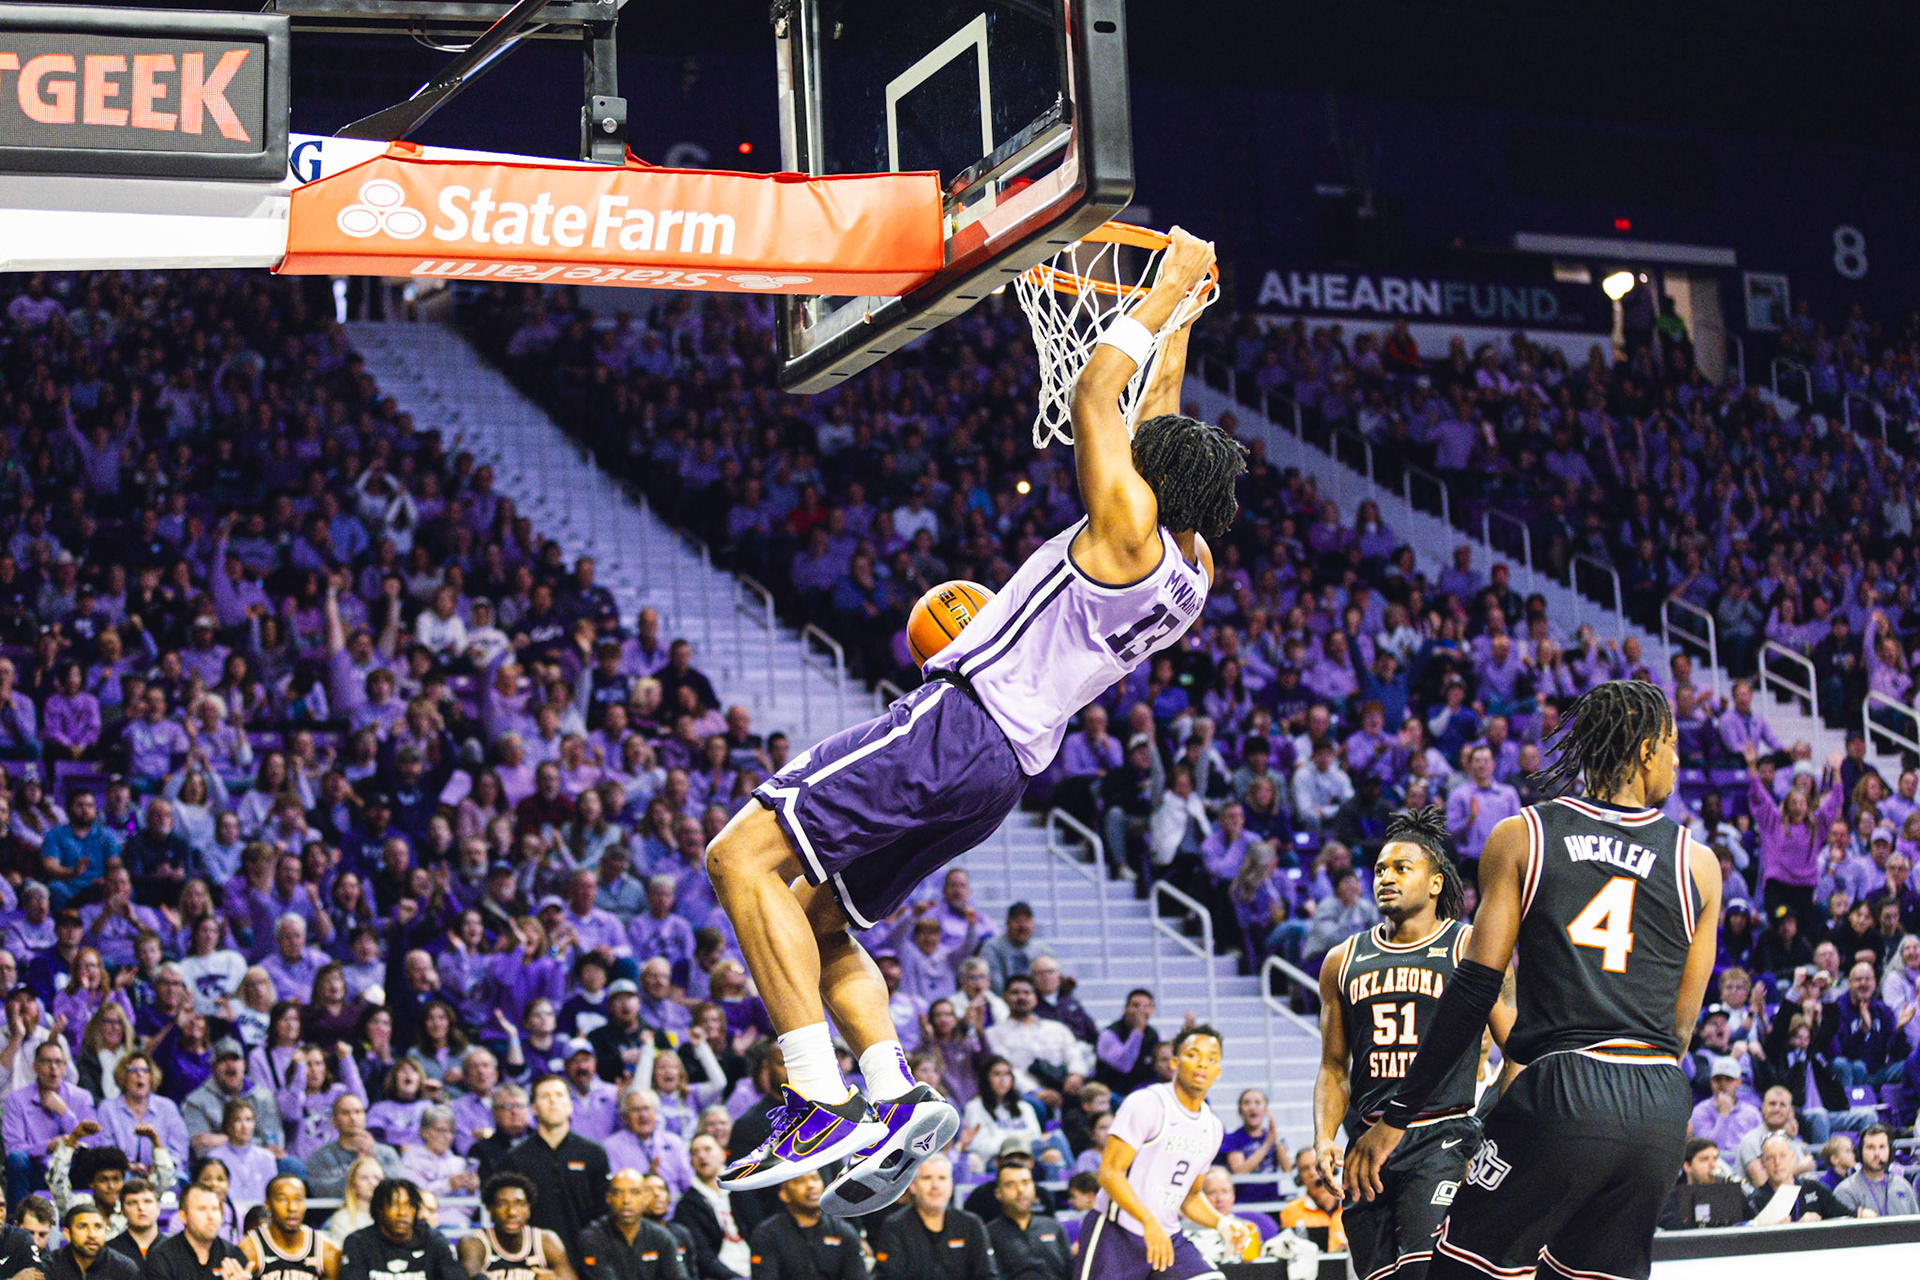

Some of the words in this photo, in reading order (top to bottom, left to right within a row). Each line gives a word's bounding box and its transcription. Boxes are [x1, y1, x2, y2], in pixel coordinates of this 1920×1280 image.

[0, 48, 250, 142] GEEK
[1834, 226, 1867, 280] 8
[1105, 603, 1180, 662] 13
[1563, 834, 1657, 879] HICKLEN
[1566, 876, 1637, 974] 4
[1350, 967, 1444, 1005] OKLAHOMA
[1371, 1001, 1418, 1046] 51
[1171, 1160, 1190, 1186] 2
